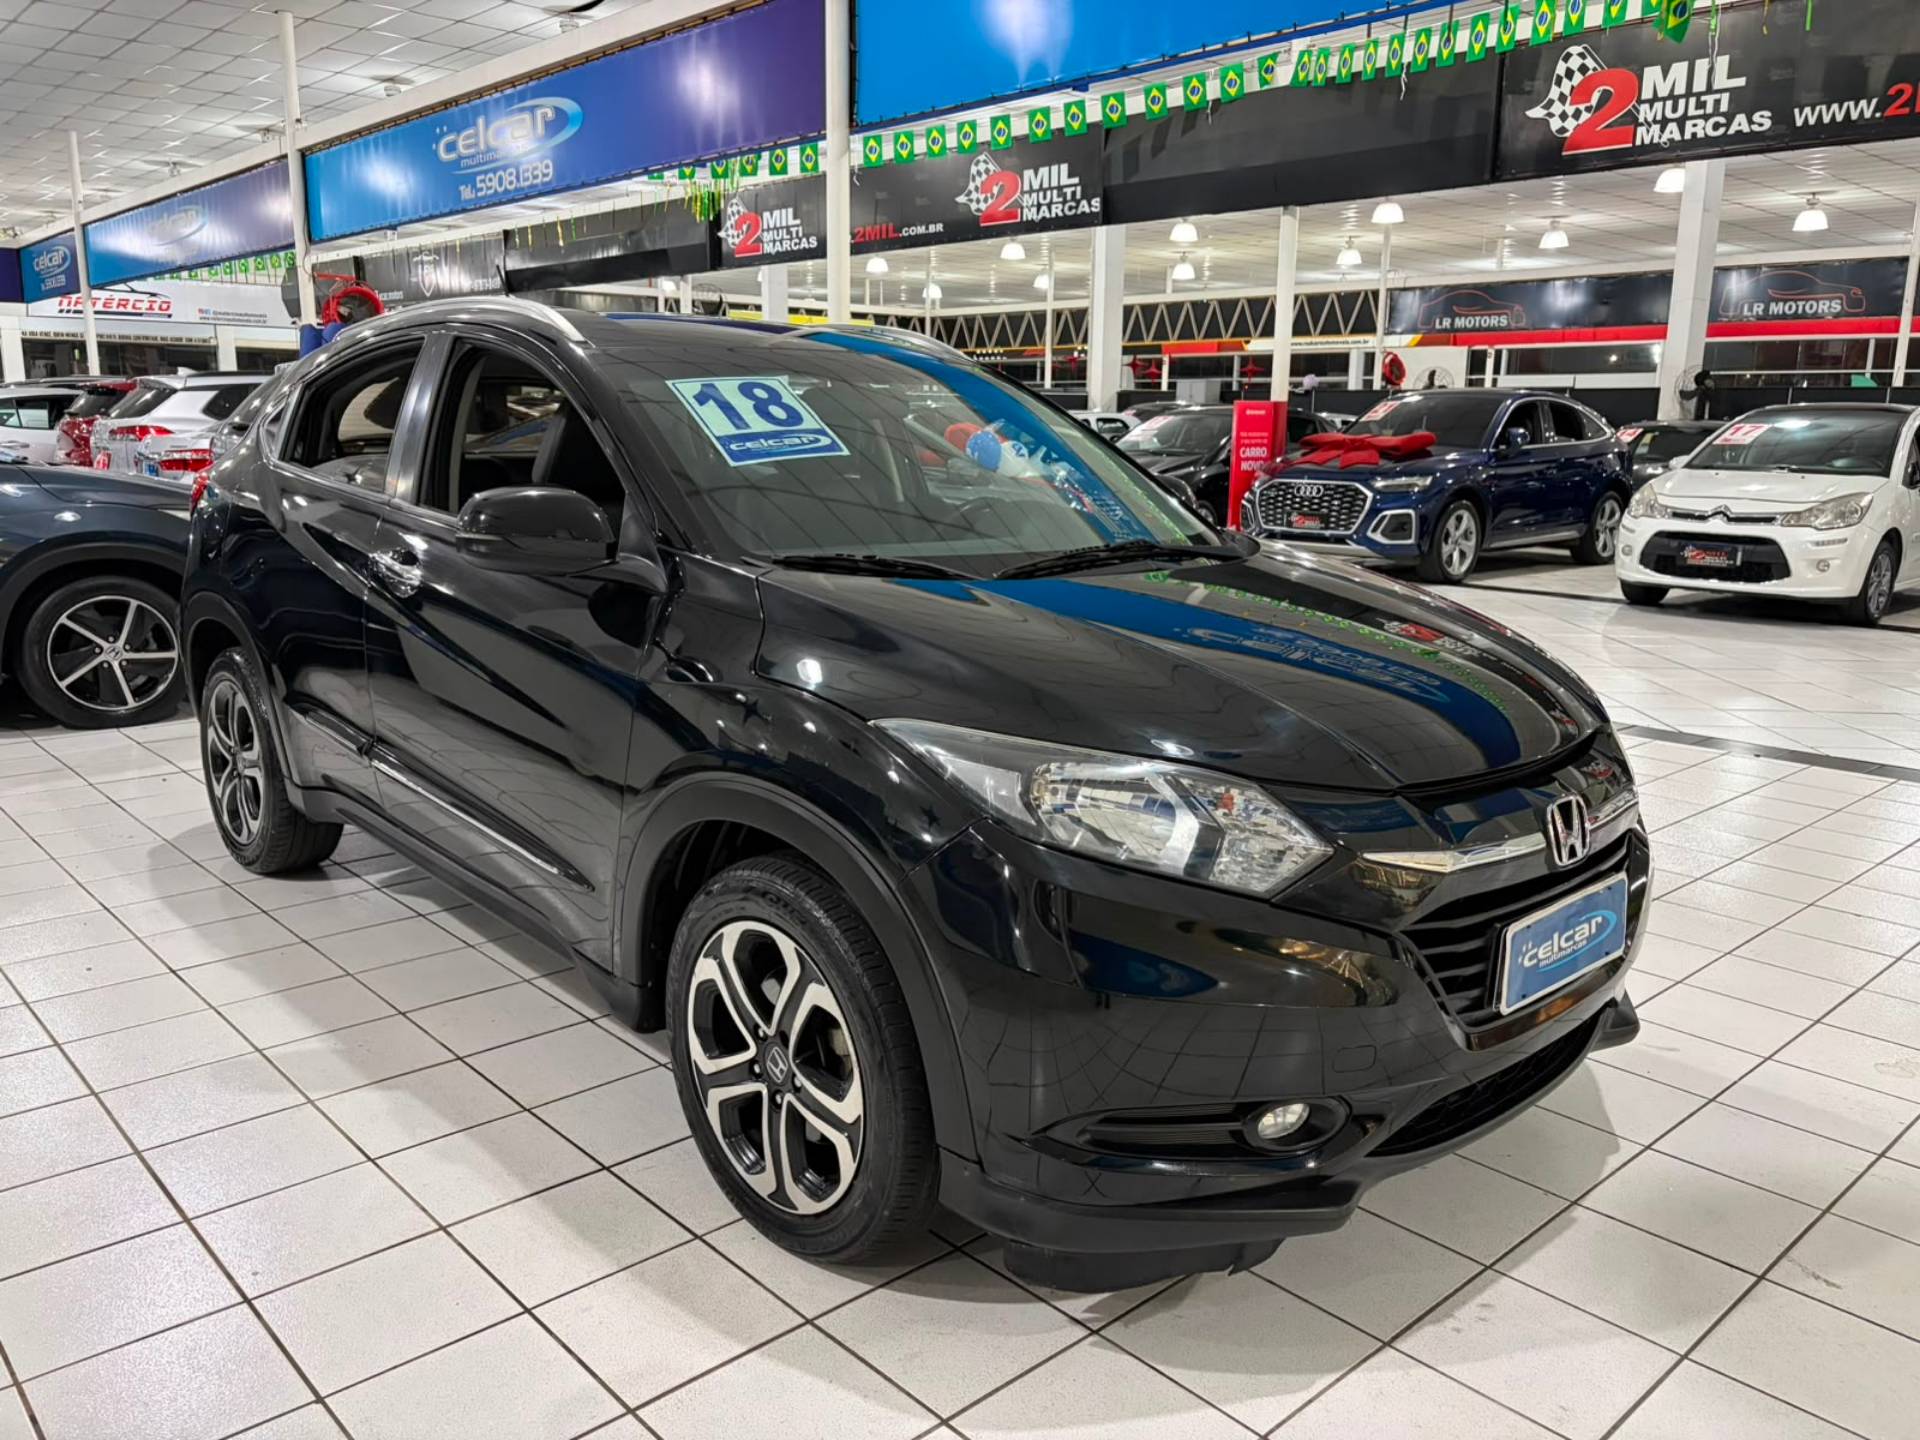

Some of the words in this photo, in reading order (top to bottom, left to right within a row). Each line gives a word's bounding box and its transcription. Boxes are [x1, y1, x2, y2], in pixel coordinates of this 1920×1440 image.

[1562, 67, 1638, 155] 2
[1641, 54, 1746, 100] MIL
[1638, 92, 1730, 123] MULTI
[437, 106, 556, 162] celcar
[1635, 110, 1772, 147] MARCAS
[476, 159, 553, 196] 5908.1339
[980, 170, 1021, 226] 2
[1023, 163, 1079, 191] MIL
[1023, 186, 1081, 207] MULTI
[1023, 197, 1100, 222] MARCAS
[735, 212, 762, 257] 2
[762, 207, 801, 230] MIL
[762, 226, 802, 243] MULTI
[763, 236, 818, 253] MARCAS
[850, 223, 944, 244] .2MIL.COM.BR
[1744, 302, 1765, 316] LR
[1769, 299, 1842, 315] MOTORS
[1435, 317, 1452, 329] LR
[1454, 315, 1508, 329] MOTORS
[692, 381, 804, 431] 18
[729, 435, 818, 450] celcar
[1729, 425, 1765, 437] 17
[1240, 447, 1267, 458] CARRO
[1523, 916, 1603, 967] celcar
[1539, 940, 1587, 968] multimarcas
